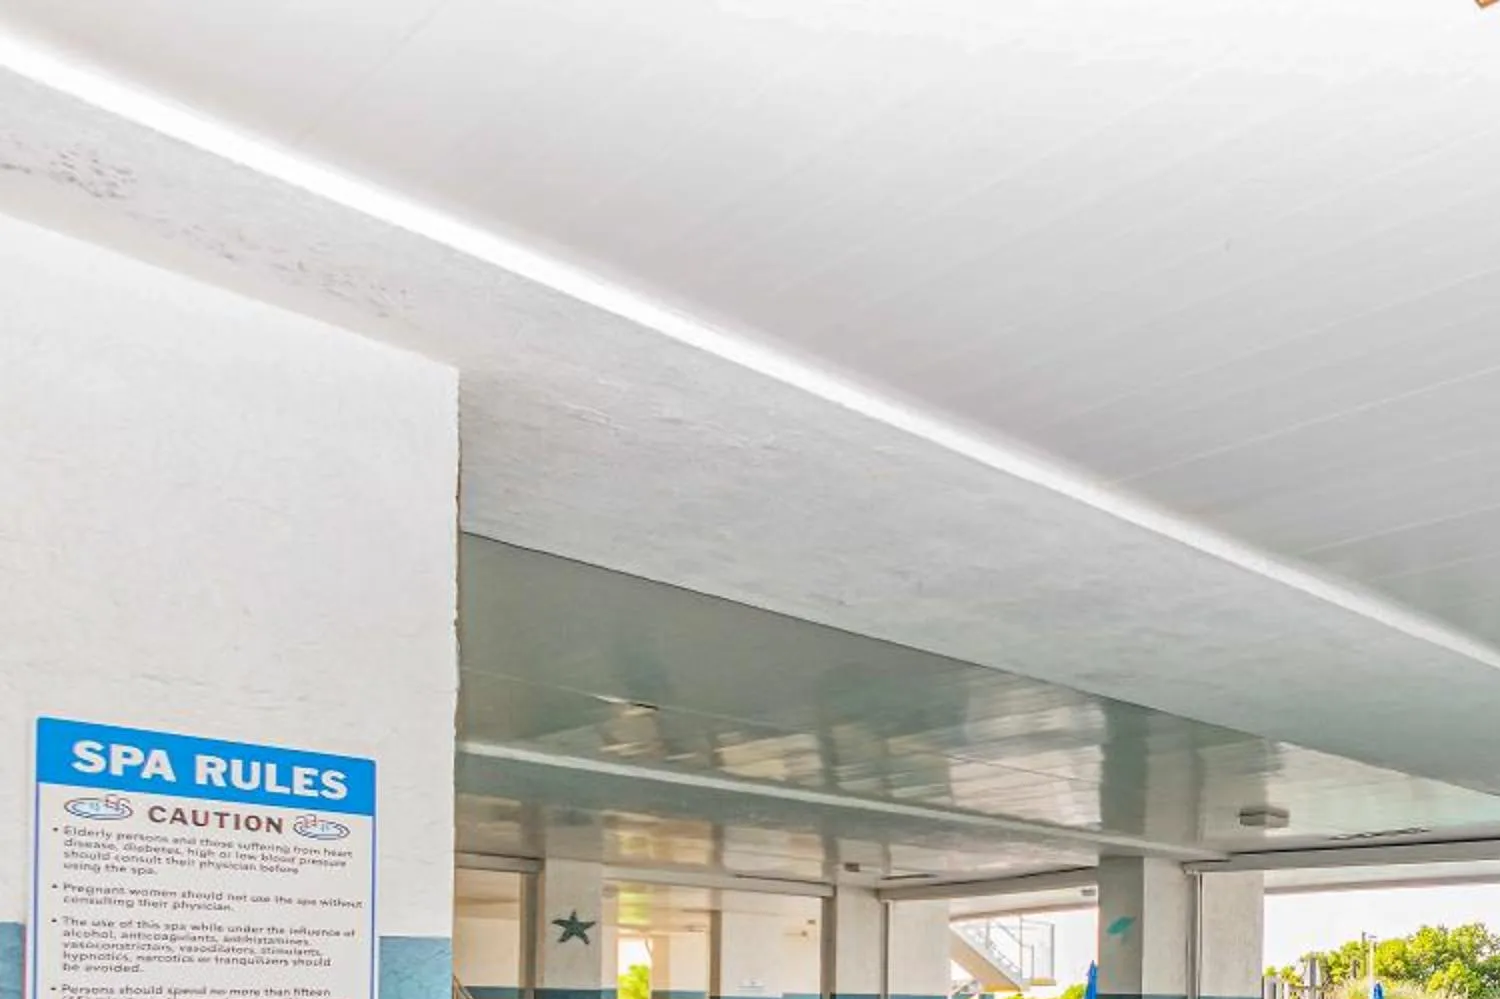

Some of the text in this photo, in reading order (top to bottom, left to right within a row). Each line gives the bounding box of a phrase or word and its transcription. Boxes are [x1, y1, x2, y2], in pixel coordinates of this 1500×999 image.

[71, 740, 348, 800] SPA RULES
[149, 805, 283, 834] CAUTION
[64, 826, 113, 839] Elderly
[105, 864, 128, 873] the
[63, 882, 125, 895] Pregnant
[129, 889, 176, 897] women
[63, 916, 86, 926] The
[120, 920, 132, 928] of
[137, 920, 160, 930] this
[164, 923, 186, 932] spa
[191, 923, 223, 932] while
[61, 984, 114, 994] Persons
[119, 985, 163, 995] should
[230, 988, 260, 996] more
